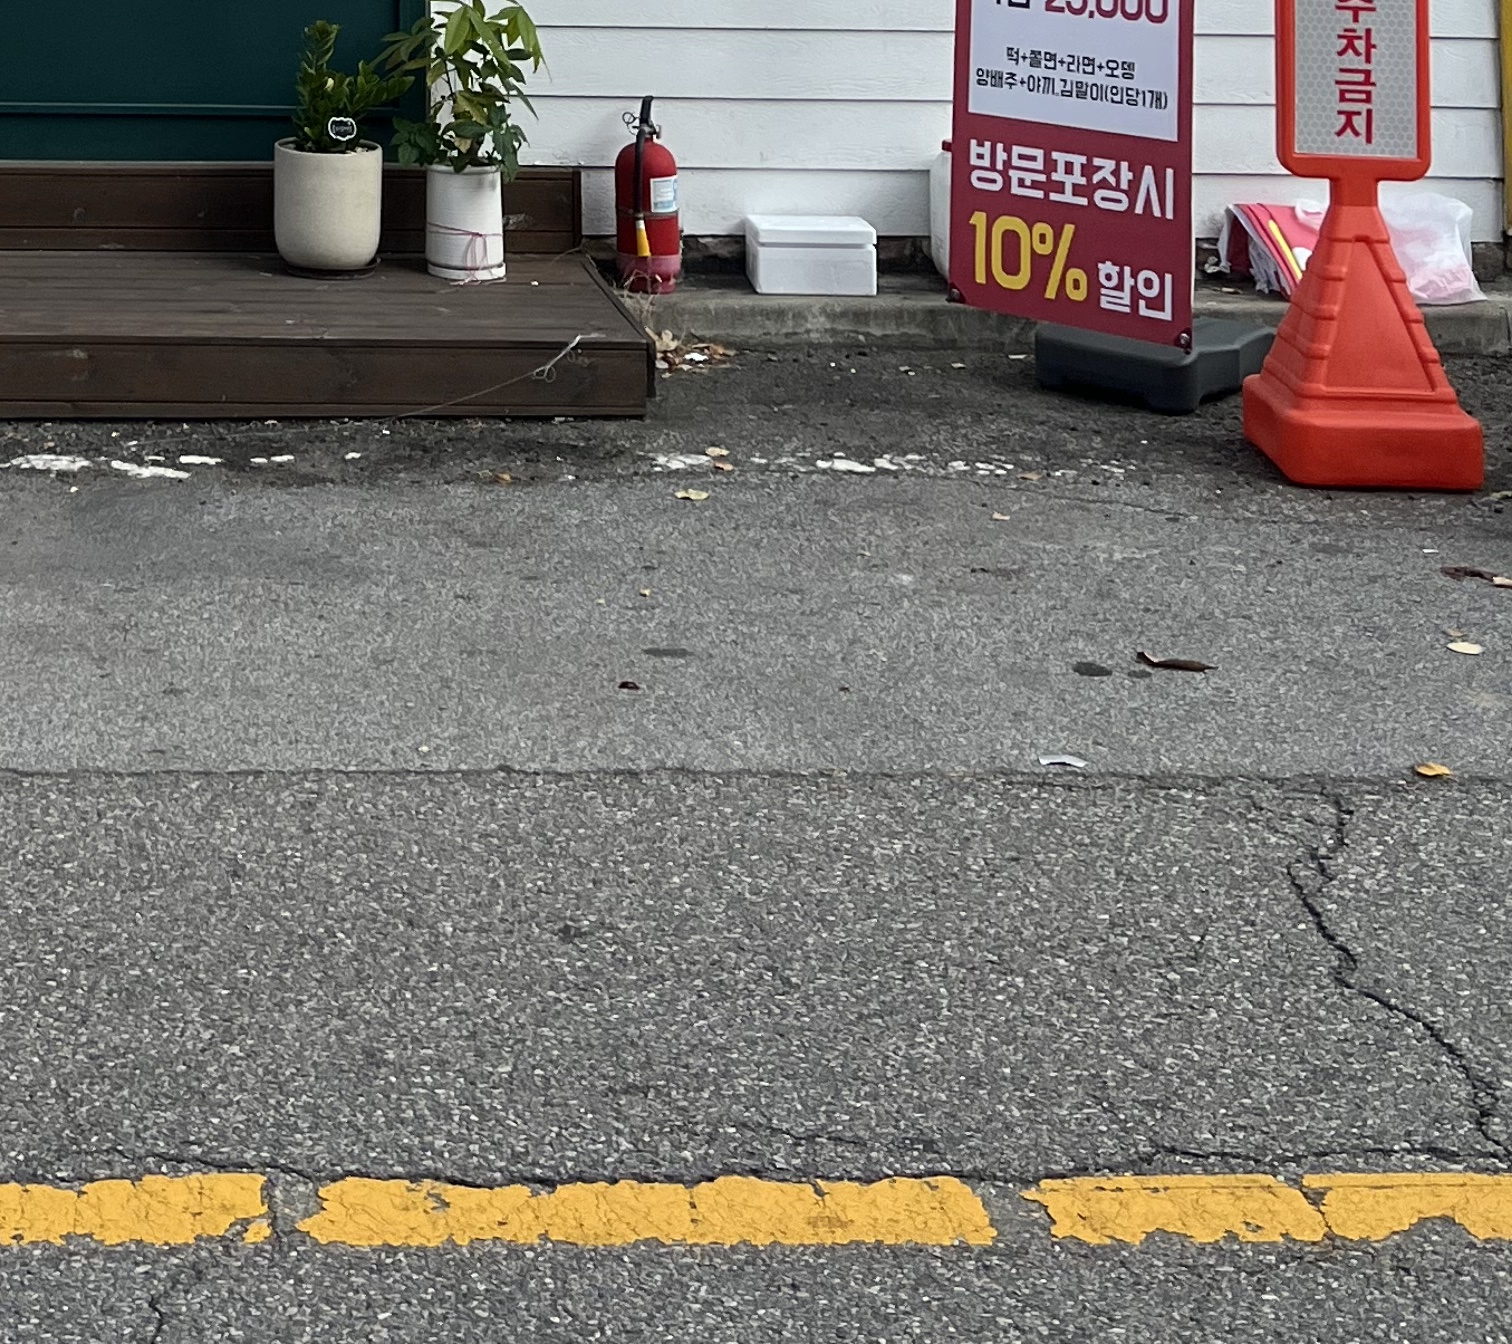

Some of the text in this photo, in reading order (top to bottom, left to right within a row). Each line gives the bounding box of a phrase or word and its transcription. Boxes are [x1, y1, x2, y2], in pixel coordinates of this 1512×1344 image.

[1006, 46, 1136, 80] 떡+쫄면+라면+오뎅
[969, 138, 1175, 220] 방문포장시
[968, 210, 1174, 322] 10% 할인
